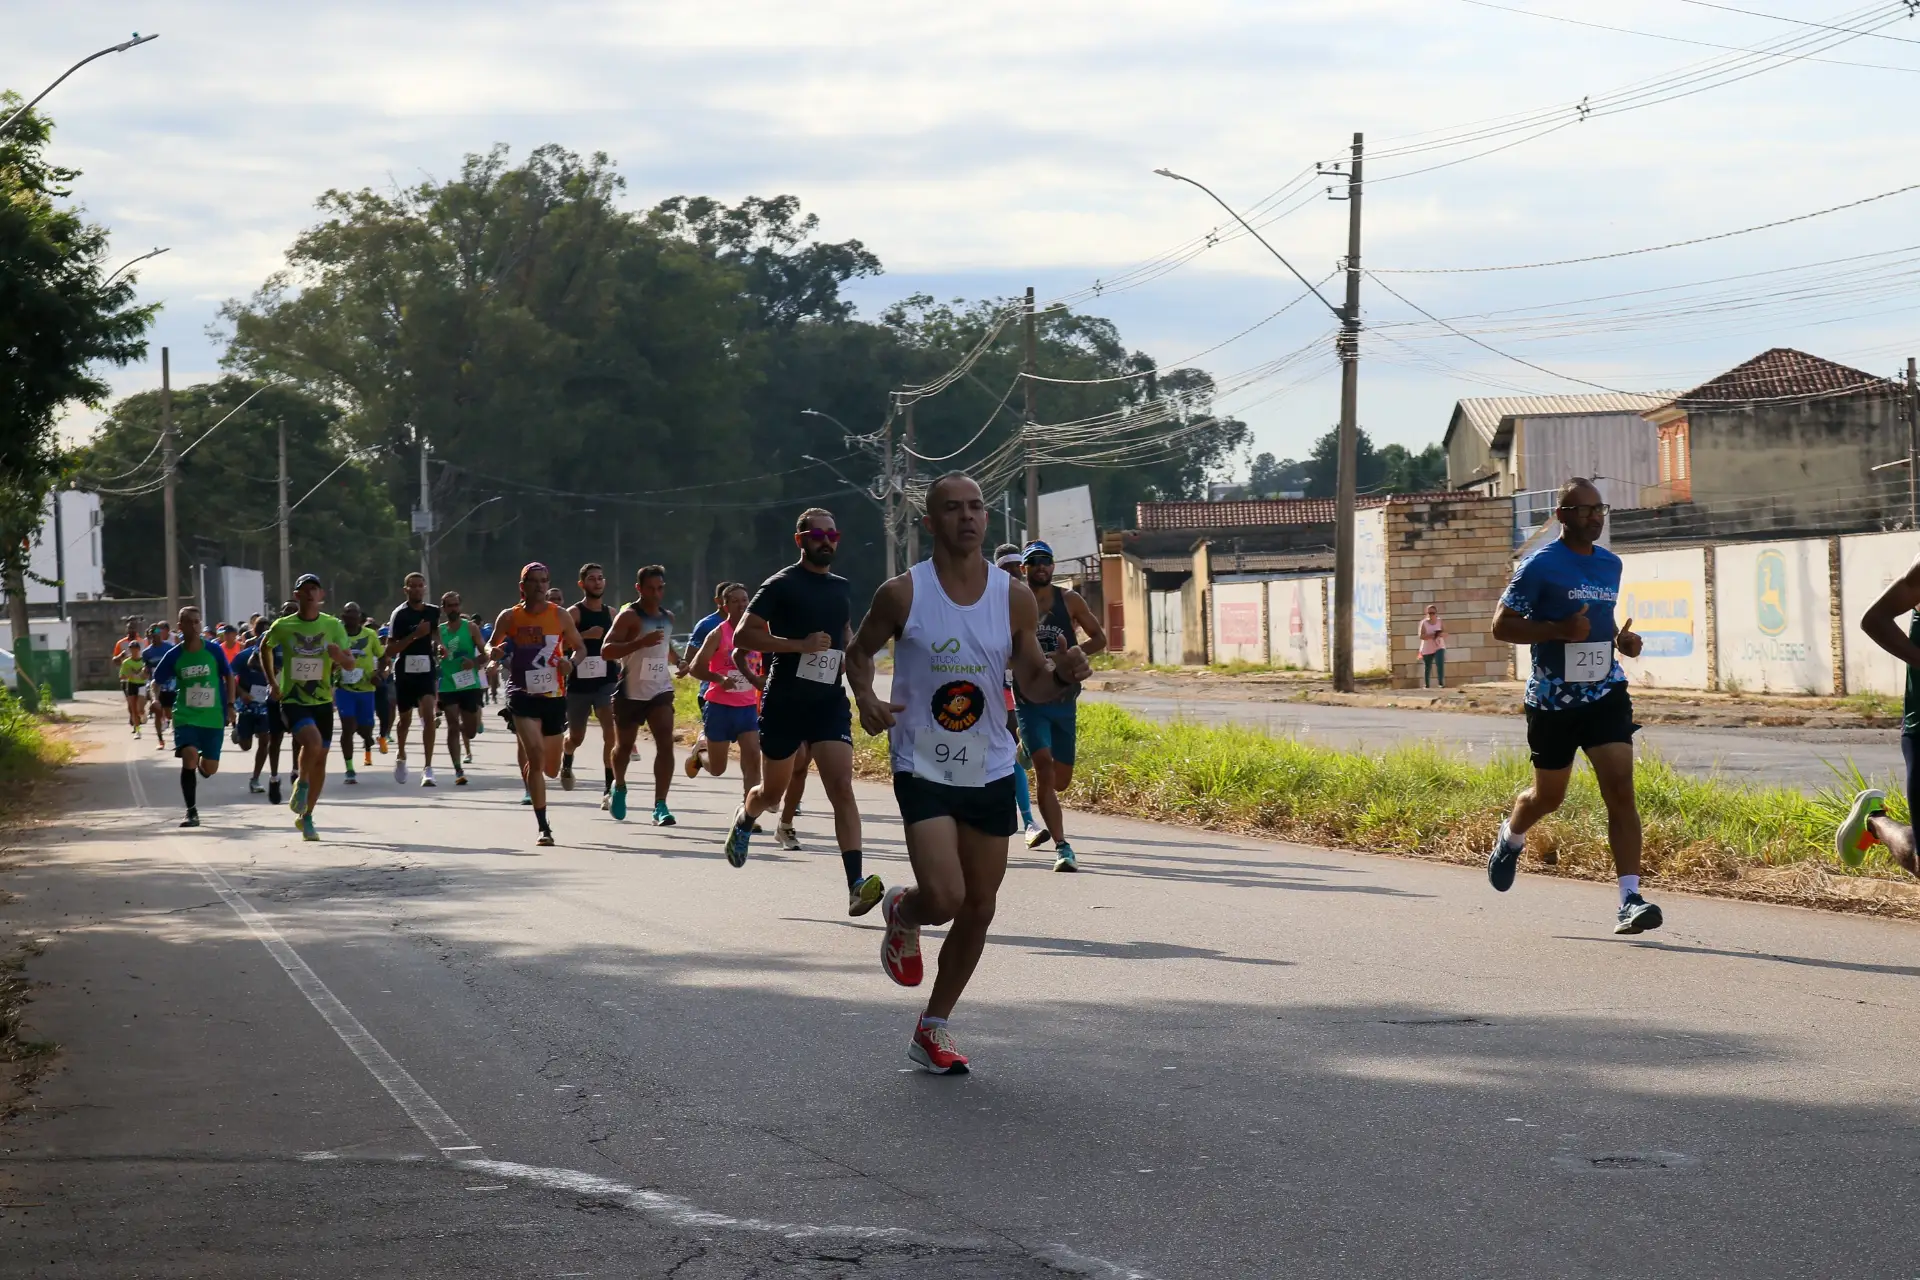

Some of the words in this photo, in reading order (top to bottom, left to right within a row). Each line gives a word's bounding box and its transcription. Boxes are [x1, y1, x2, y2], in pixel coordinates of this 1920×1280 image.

[806, 653, 837, 671] 280
[931, 655, 961, 664] STUDIO
[1576, 651, 1604, 667] 215
[296, 663, 318, 673] 297
[584, 660, 600, 670] 151
[647, 663, 664, 673] 148
[930, 664, 988, 675] MOVEMENT
[532, 673, 553, 685] 319
[191, 691, 210, 700] 279
[935, 743, 969, 766] 94
